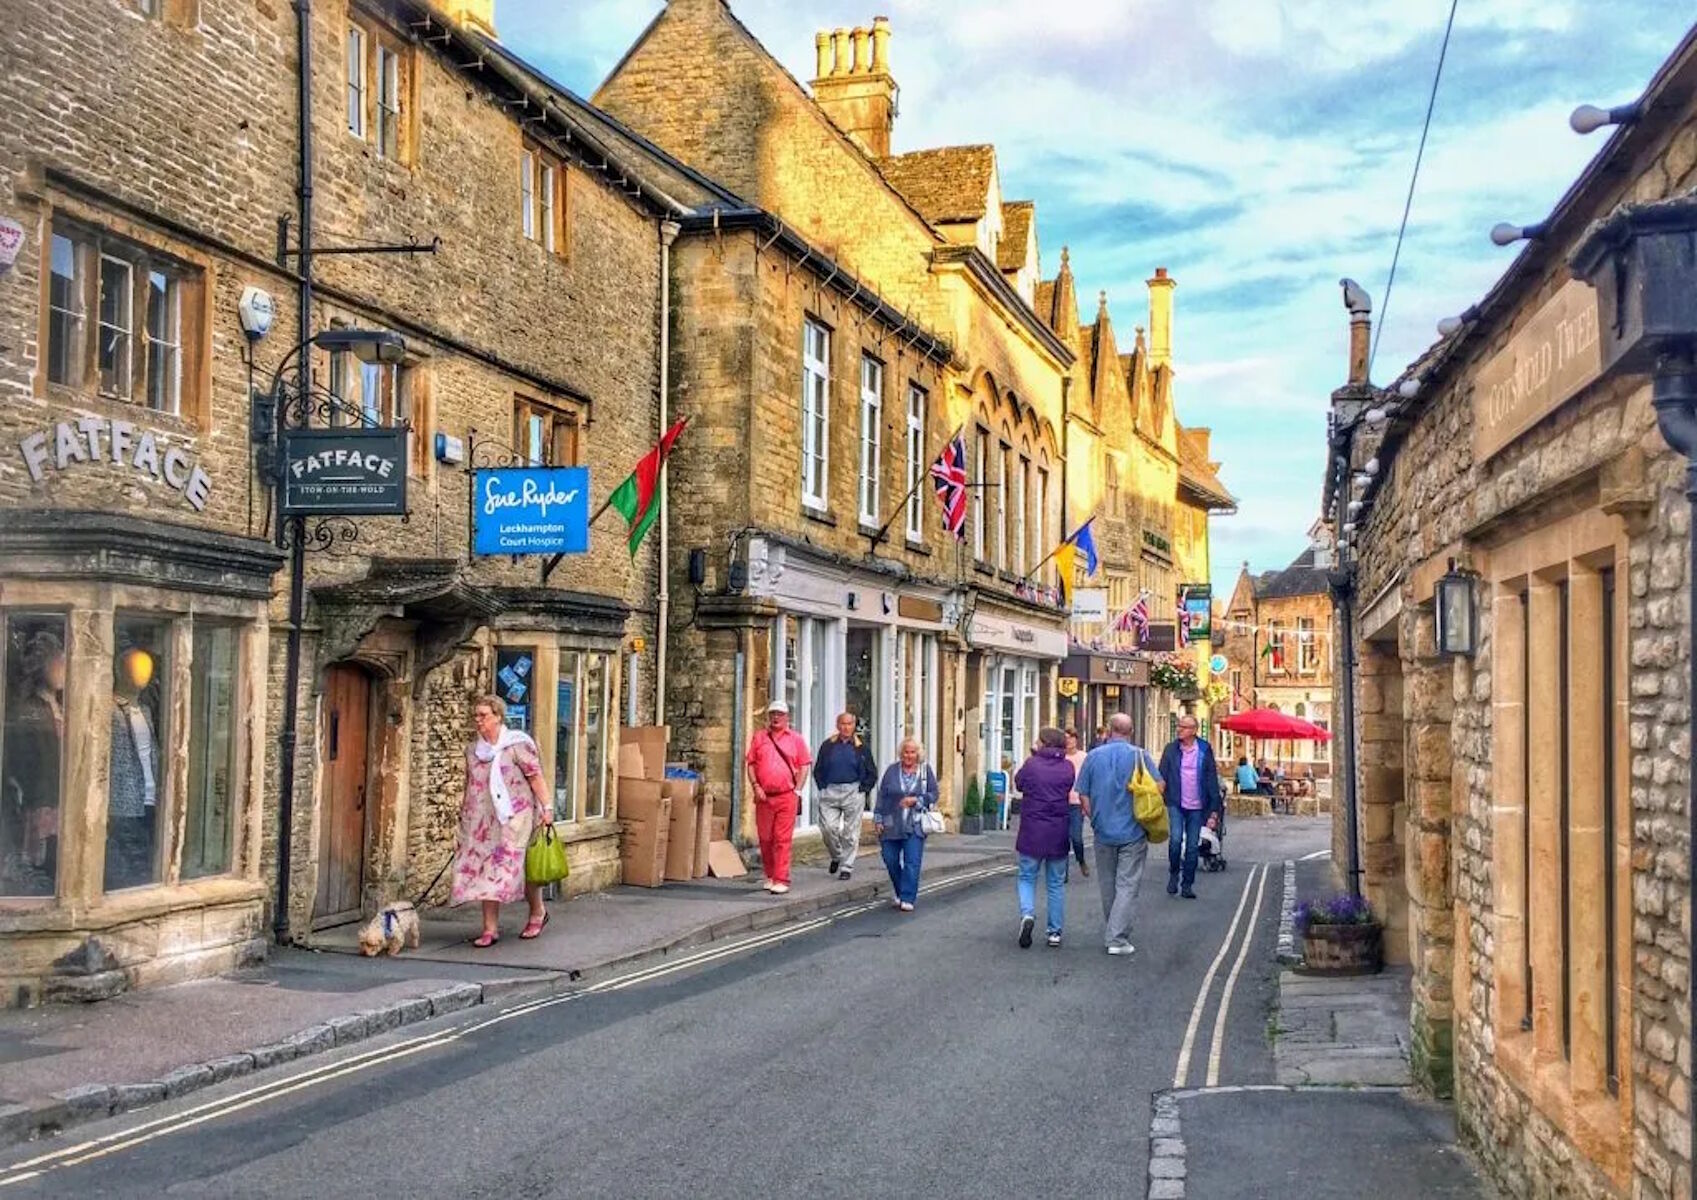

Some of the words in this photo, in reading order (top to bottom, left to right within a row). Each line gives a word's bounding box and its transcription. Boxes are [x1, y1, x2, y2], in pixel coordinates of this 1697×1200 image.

[1556, 304, 1597, 369] TWEE
[20, 418, 212, 512] FATFACE
[291, 450, 394, 479] FATFACE
[484, 477, 521, 515] Sue
[523, 479, 579, 518] Ryder
[500, 524, 565, 534] Leckhampton
[500, 537, 526, 546] Court
[528, 537, 564, 547] Hospice
